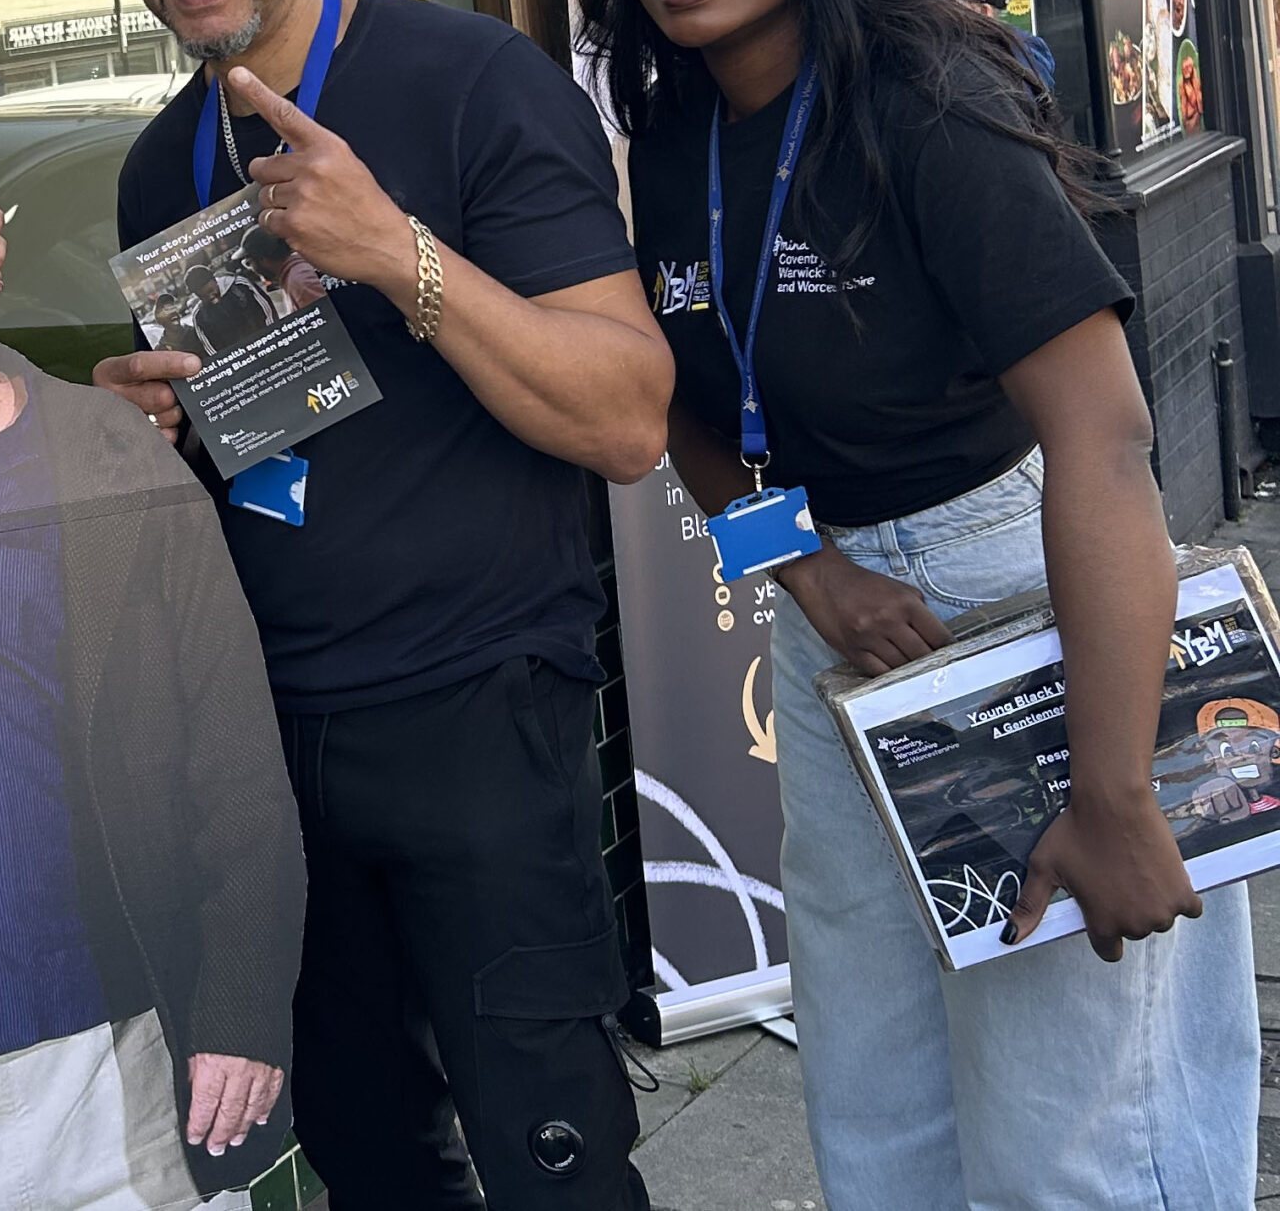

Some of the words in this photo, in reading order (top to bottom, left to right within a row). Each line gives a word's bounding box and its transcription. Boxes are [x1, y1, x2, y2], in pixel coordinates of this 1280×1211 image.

[135, 246, 160, 264] Your
[159, 231, 192, 254] story,
[190, 210, 229, 236] culture
[228, 199, 250, 216] and
[143, 251, 180, 275] mental
[181, 233, 214, 256] health
[214, 213, 254, 239] matter.
[777, 281, 795, 293] and
[216, 346, 246, 366] health
[245, 328, 281, 352] support
[280, 306, 321, 333] designed
[190, 380, 205, 392] for
[204, 366, 233, 386] young
[232, 353, 257, 370] Black
[256, 343, 277, 357] men
[276, 330, 299, 348] aged
[199, 386, 232, 408] Culturally
[231, 366, 270, 391] appropriate
[306, 339, 321, 350] and
[204, 401, 224, 416] group
[223, 382, 259, 405] workshops
[258, 378, 266, 386] in
[265, 359, 303, 383] community
[303, 347, 326, 363] venues
[207, 413, 219, 423] for
[218, 403, 240, 418] young
[239, 392, 258, 406] Black
[258, 385, 273, 396] men
[272, 377, 287, 388] and
[286, 368, 303, 381] their
[302, 353, 331, 373] families.
[308, 374, 351, 410] YBM
[666, 482, 683, 506] in
[1171, 620, 1233, 667] YBM
[966, 700, 1014, 726] Young
[1014, 685, 1054, 709] Black
[890, 738, 923, 754] Coventry,
[894, 741, 937, 760] Warwickshire
[897, 759, 910, 767] and
[910, 742, 959, 763] Worcestershire
[992, 726, 1002, 739] A
